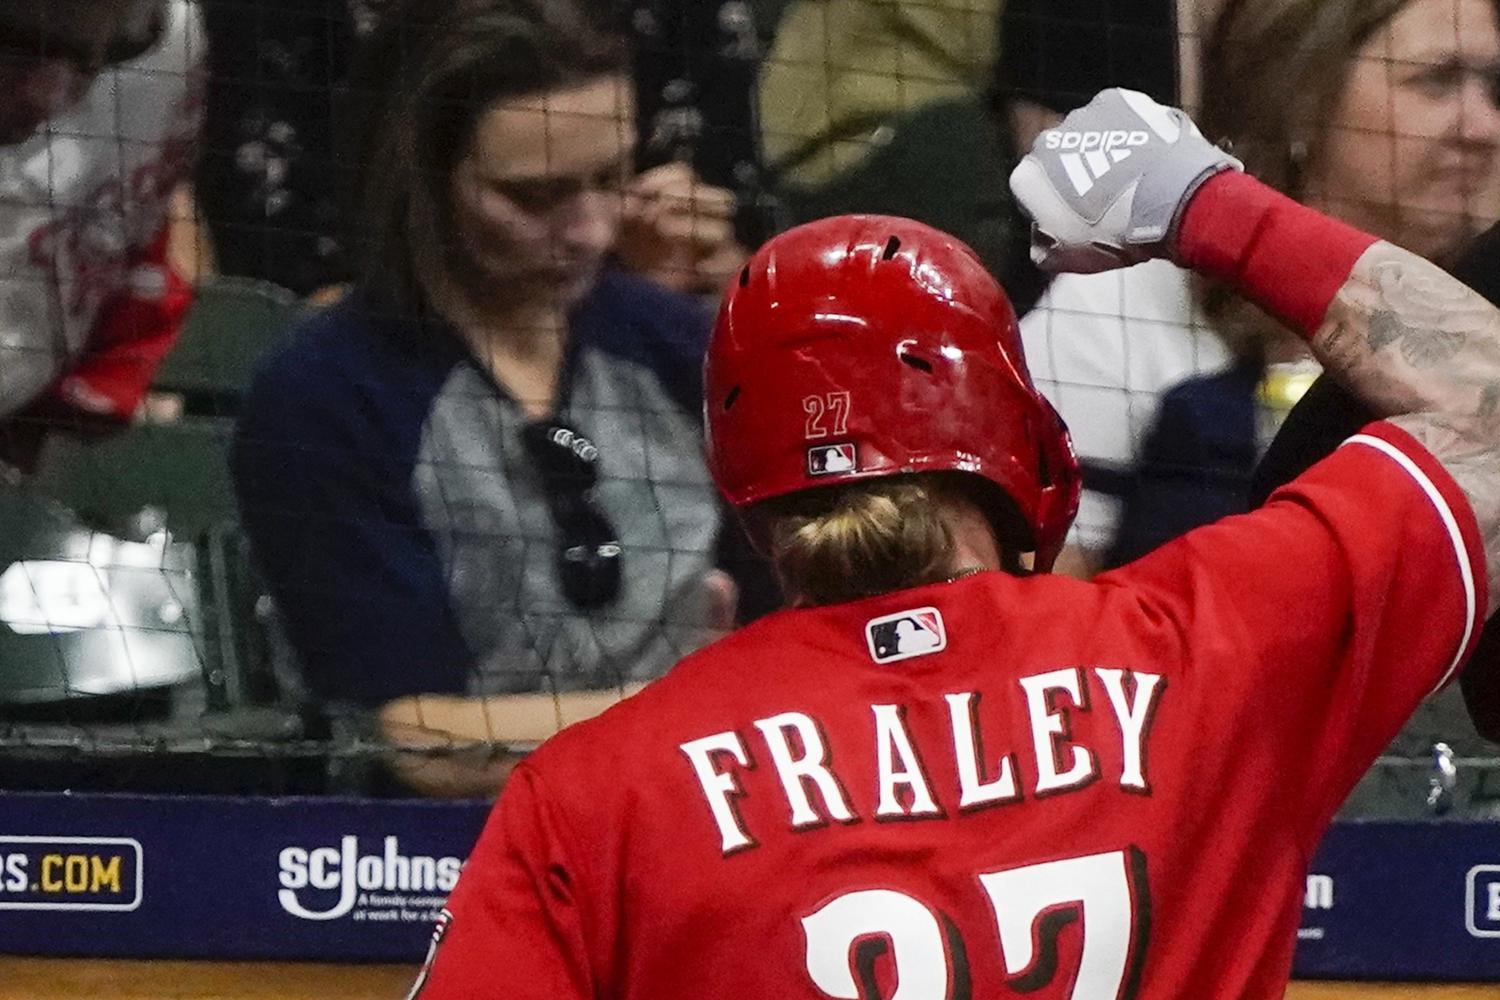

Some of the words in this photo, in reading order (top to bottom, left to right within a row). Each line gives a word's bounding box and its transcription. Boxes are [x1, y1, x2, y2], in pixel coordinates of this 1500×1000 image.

[1045, 129, 1149, 152] adidas
[802, 391, 850, 439] 27
[680, 667, 1165, 855] FRALEY
[0, 853, 121, 893] S.COM
